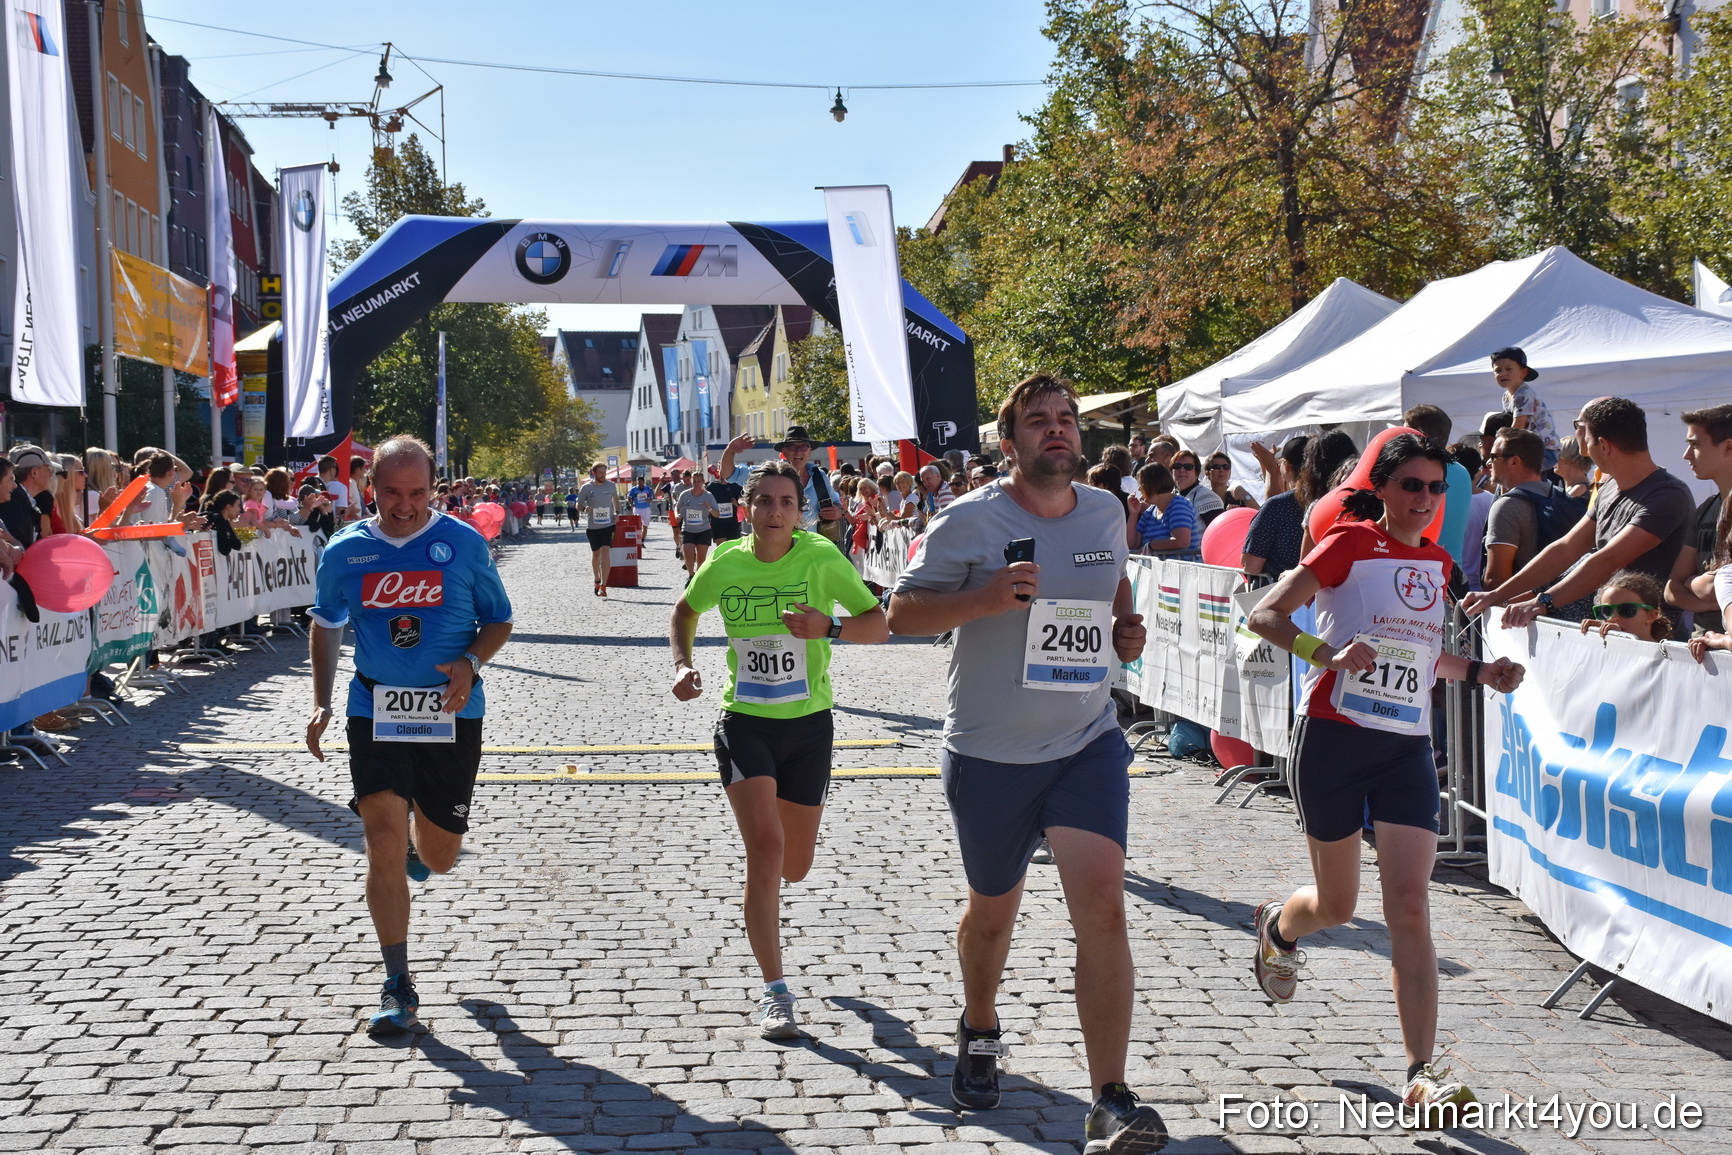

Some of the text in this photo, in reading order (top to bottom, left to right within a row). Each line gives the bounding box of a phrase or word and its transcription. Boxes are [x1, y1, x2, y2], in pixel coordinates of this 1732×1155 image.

[342, 272, 421, 326] NEUMARKT
[904, 318, 951, 352] MARKT
[347, 554, 380, 565] Kappa
[434, 546, 447, 559] N
[1073, 551, 1115, 564] BOCK
[362, 571, 443, 608] Lete
[1056, 607, 1093, 618] BOCK
[752, 640, 784, 649] BOCK
[1041, 624, 1101, 653] 2490
[1377, 645, 1416, 660] BOCK
[747, 651, 795, 675] 3016
[1052, 669, 1090, 681] Markus
[1358, 661, 1419, 693] 2178
[385, 690, 442, 713] 2073
[1362, 687, 1407, 702] PARTL Neumarkt
[1371, 702, 1399, 718] Doris
[396, 725, 433, 735] Claudio
